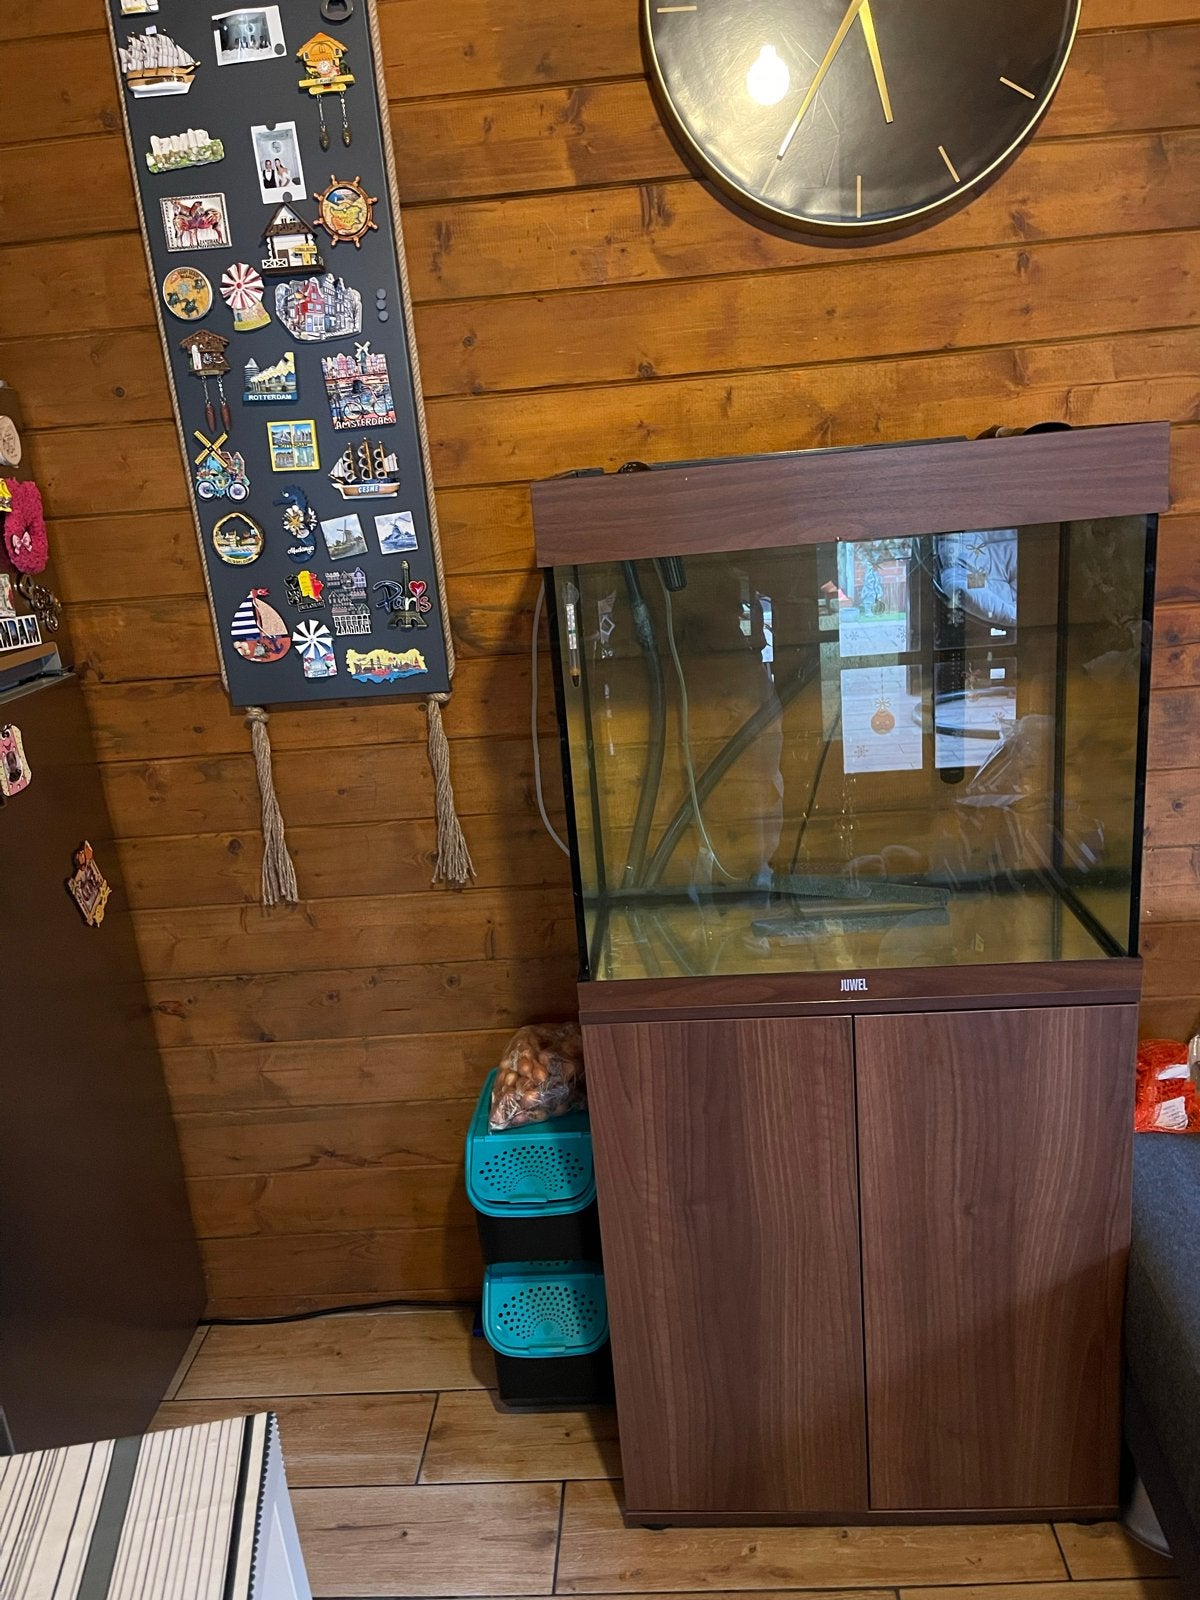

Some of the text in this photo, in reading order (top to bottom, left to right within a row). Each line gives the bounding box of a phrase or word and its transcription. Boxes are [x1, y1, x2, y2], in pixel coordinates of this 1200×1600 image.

[335, 416, 394, 430] AMSTERDAM
[373, 580, 432, 613] Paris
[840, 978, 868, 992] JUWEL
